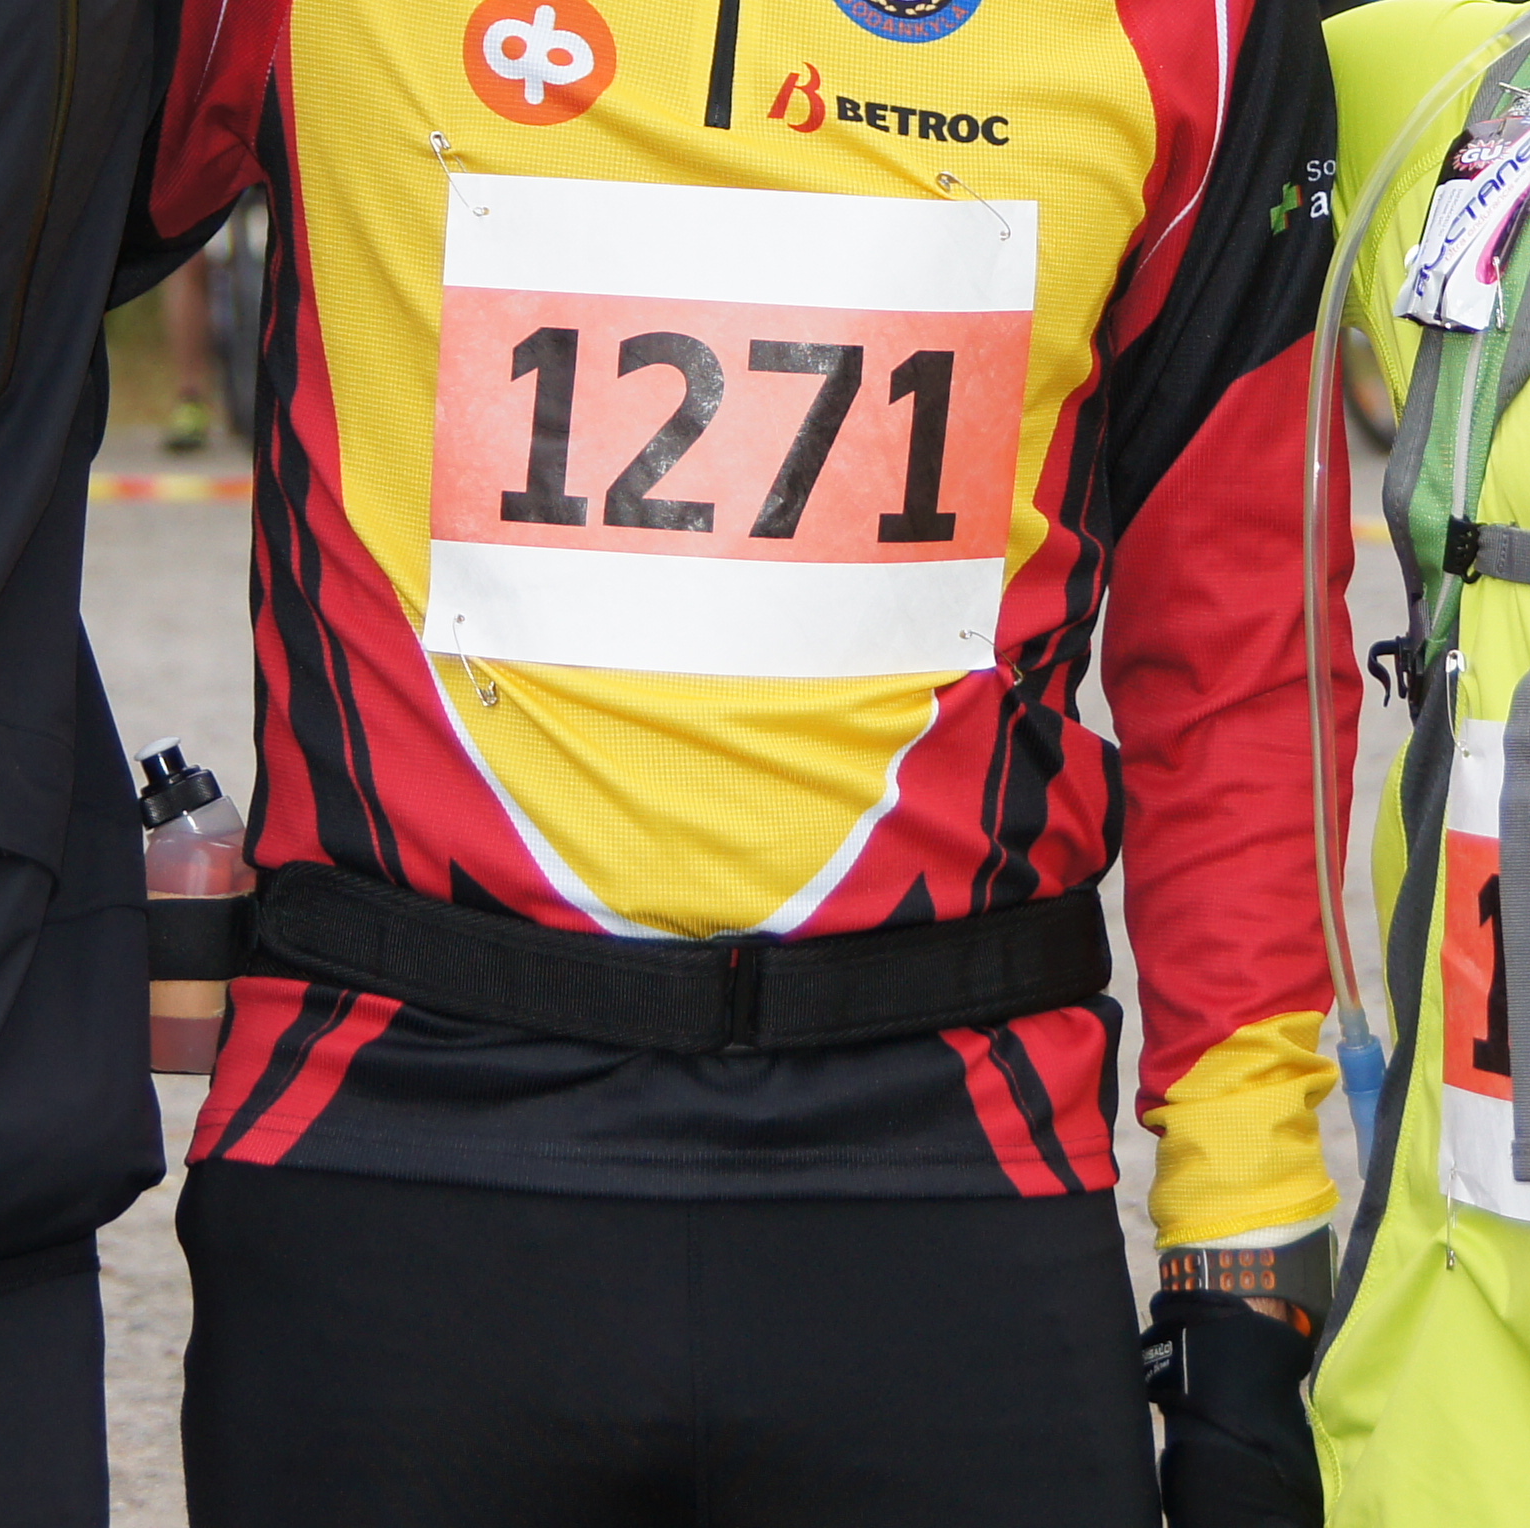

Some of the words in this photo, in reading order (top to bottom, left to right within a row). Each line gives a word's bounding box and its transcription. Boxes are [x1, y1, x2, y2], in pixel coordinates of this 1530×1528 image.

[836, 95, 1010, 146] BETROC
[1461, 144, 1504, 164] GU
[499, 326, 957, 544] 1271
